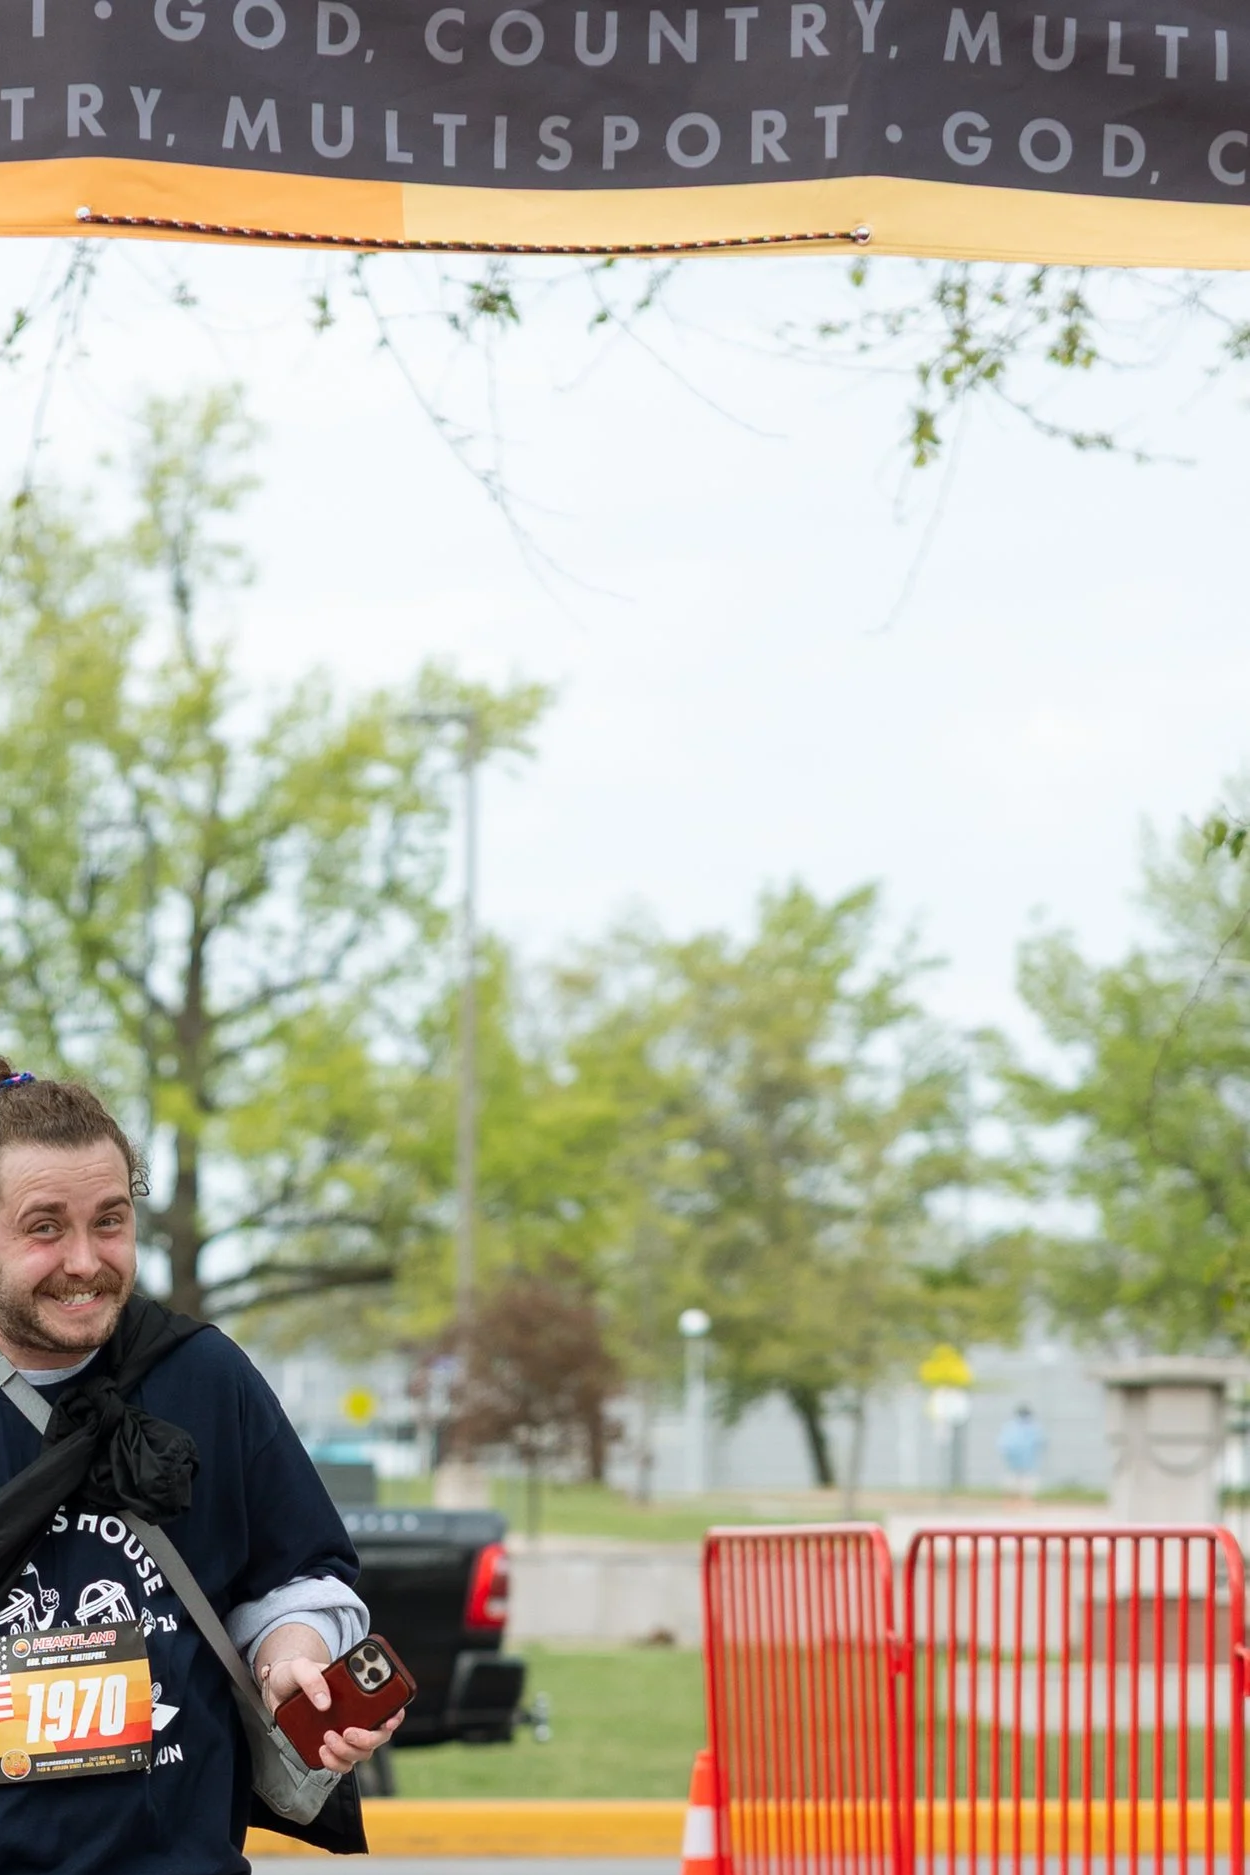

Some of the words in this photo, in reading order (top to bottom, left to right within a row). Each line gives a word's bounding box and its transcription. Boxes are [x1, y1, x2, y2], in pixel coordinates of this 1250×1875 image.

[154, 0, 374, 63] GOD,
[424, 0, 898, 67] COUNTRY,
[943, 7, 1229, 81] MULTI
[222, 96, 849, 172] MULTISPORT
[942, 110, 1159, 184] GOD,
[77, 1513, 163, 1597] HOUSE
[32, 1629, 117, 1651] HEARTLAND
[26, 1674, 127, 1744] 1970
